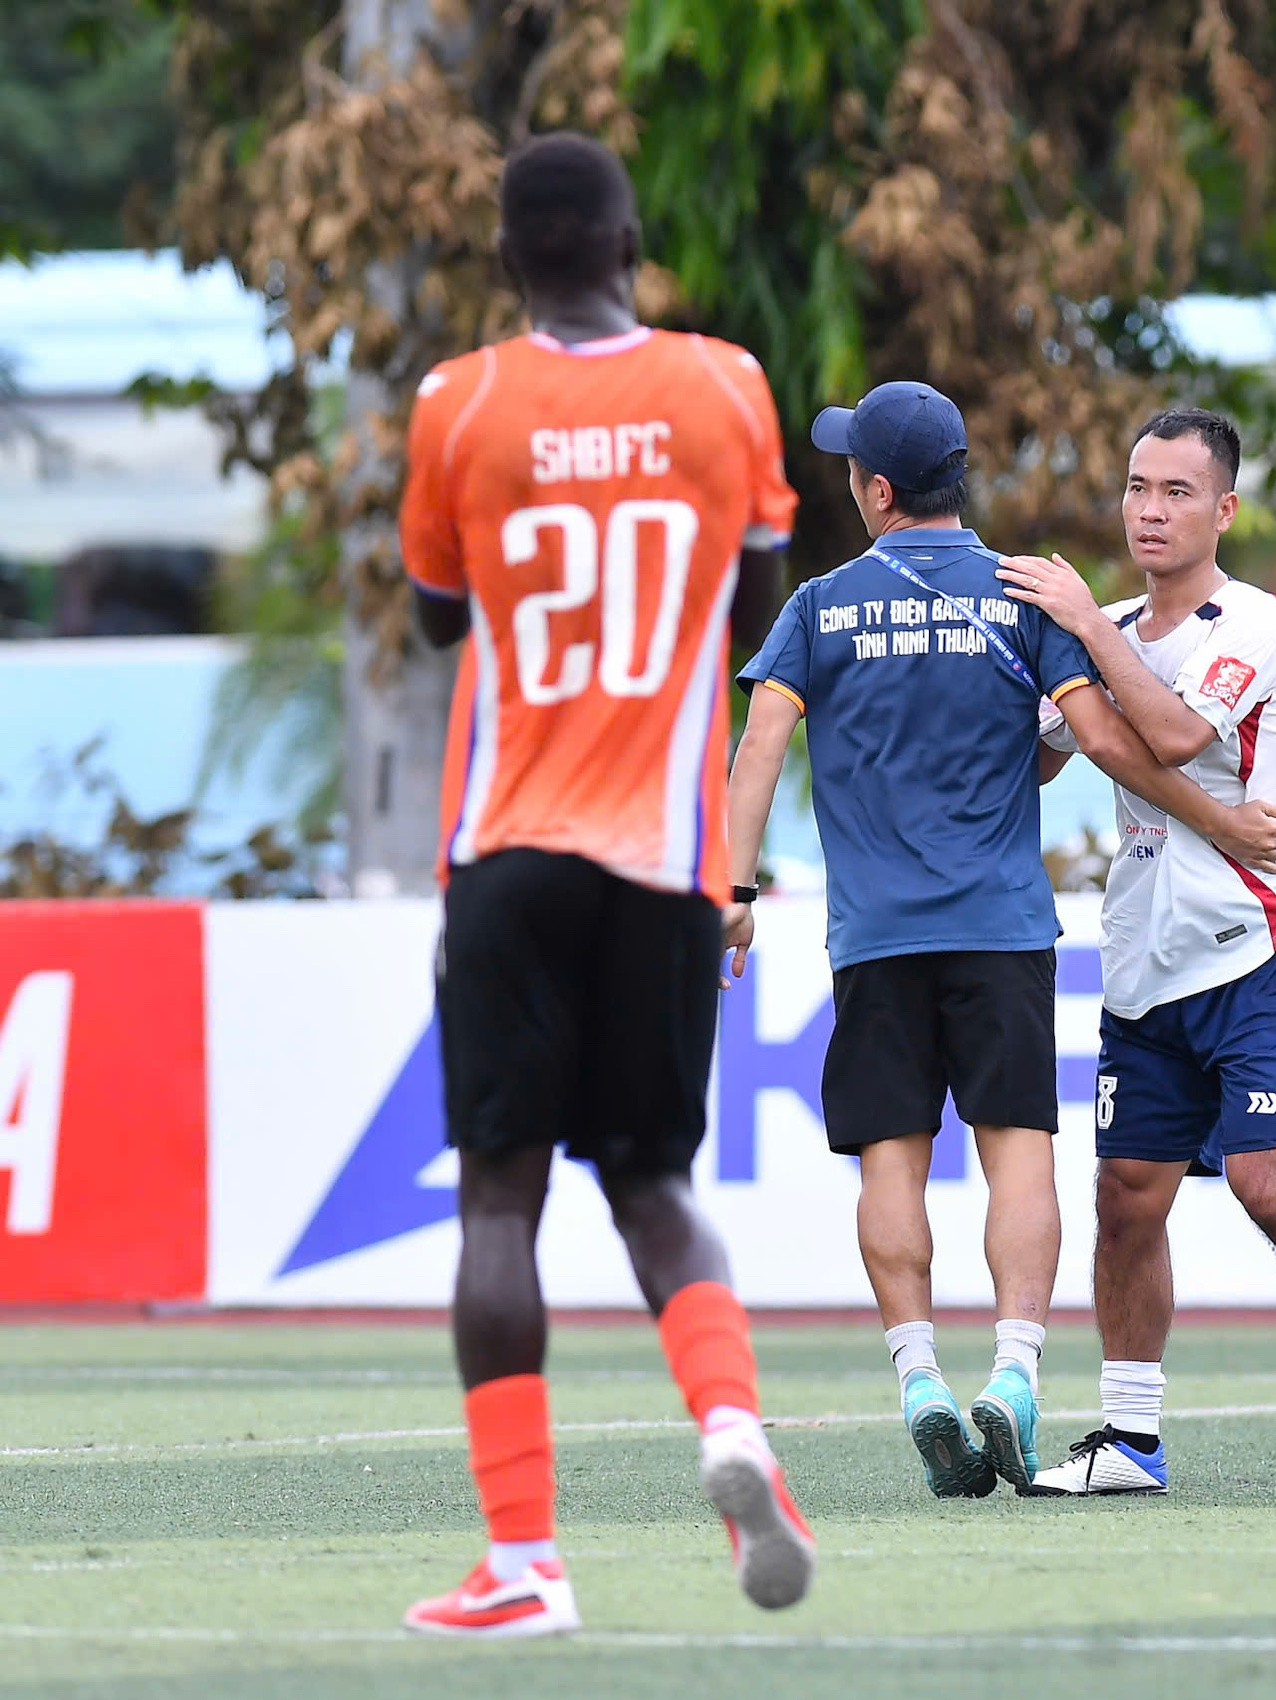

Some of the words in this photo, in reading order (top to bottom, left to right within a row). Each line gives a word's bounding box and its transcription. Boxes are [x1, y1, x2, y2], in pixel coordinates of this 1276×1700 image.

[501, 500, 699, 706] 20
[819, 604, 859, 634] CÔNG
[863, 599, 884, 626] TY
[890, 596, 927, 628] ĐIỆN
[980, 597, 1019, 628] KHOA
[892, 628, 929, 656] NINH
[935, 625, 987, 657] THUẬN
[1097, 1075, 1118, 1130] 8
